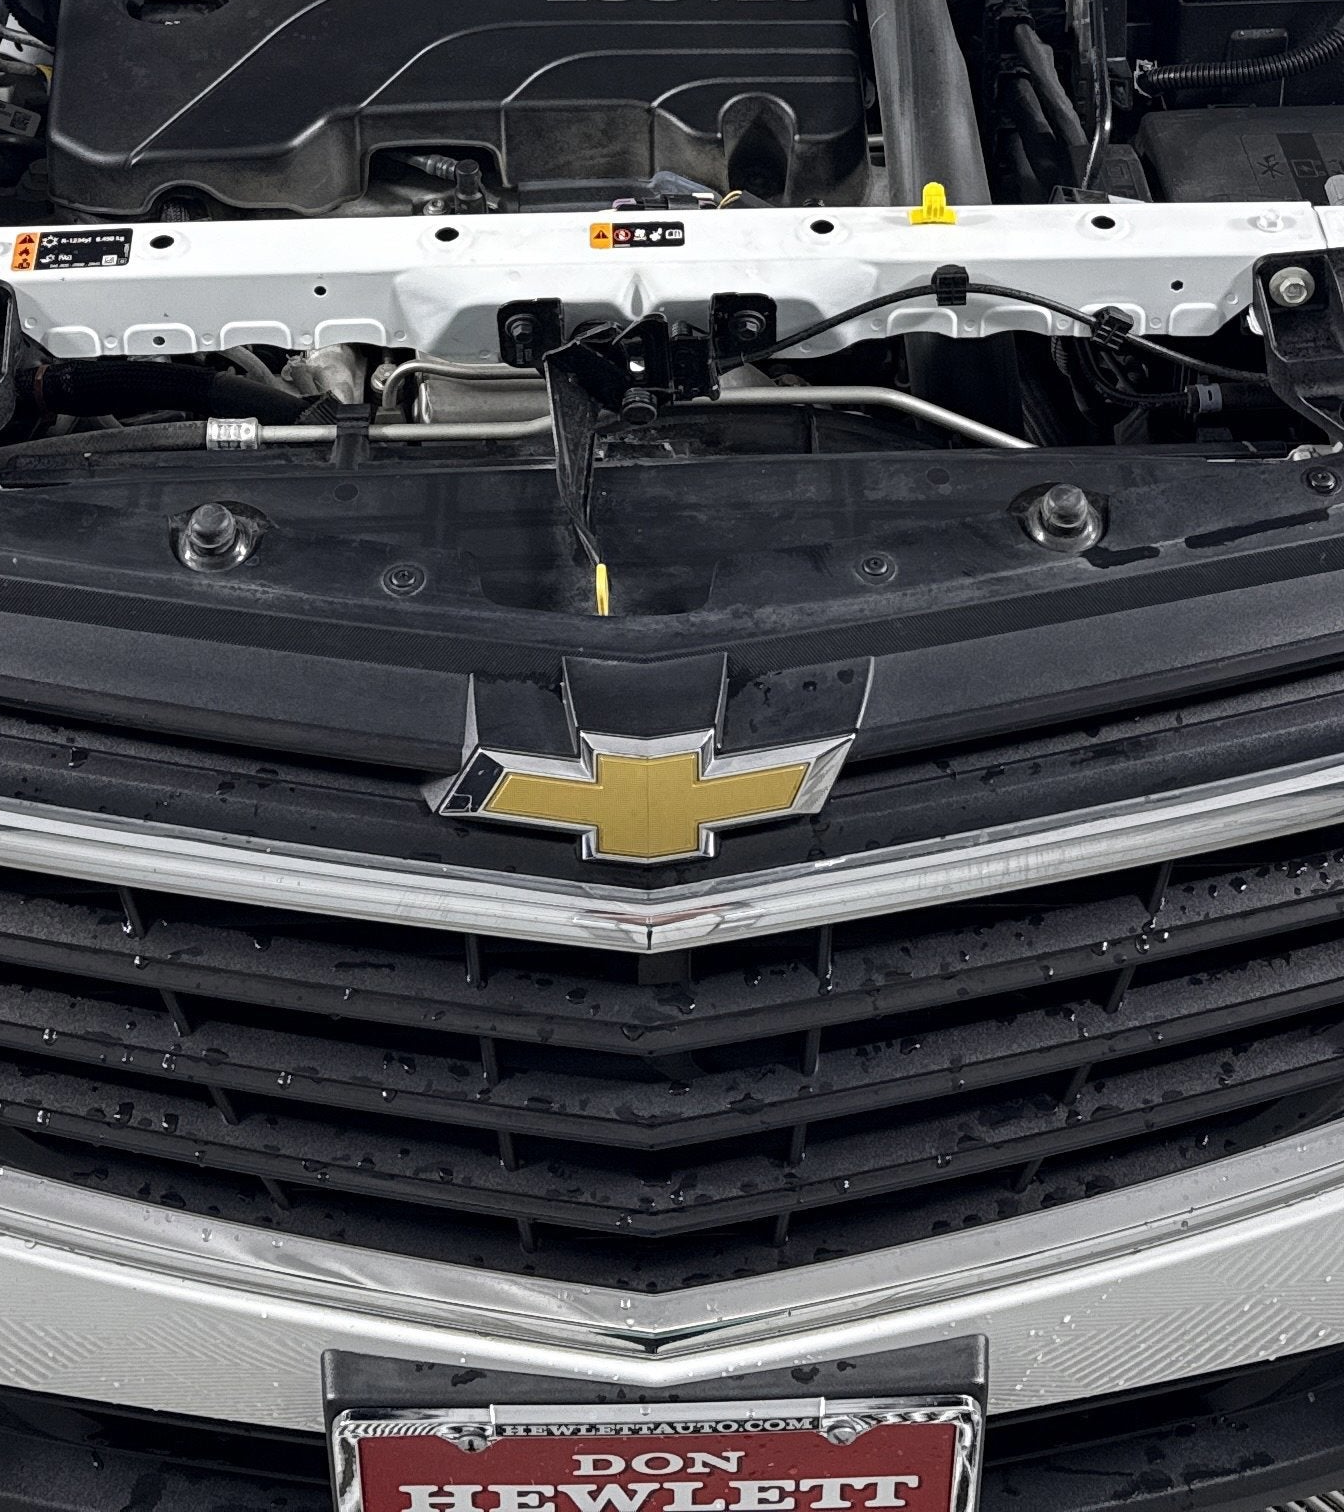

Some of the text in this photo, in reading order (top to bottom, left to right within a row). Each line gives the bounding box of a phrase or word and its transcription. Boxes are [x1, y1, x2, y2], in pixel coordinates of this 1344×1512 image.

[503, 1418, 813, 1436] HEWLETTAUTO.COM
[572, 1451, 746, 1476] DON
[398, 1475, 919, 1512] HEWLETT
